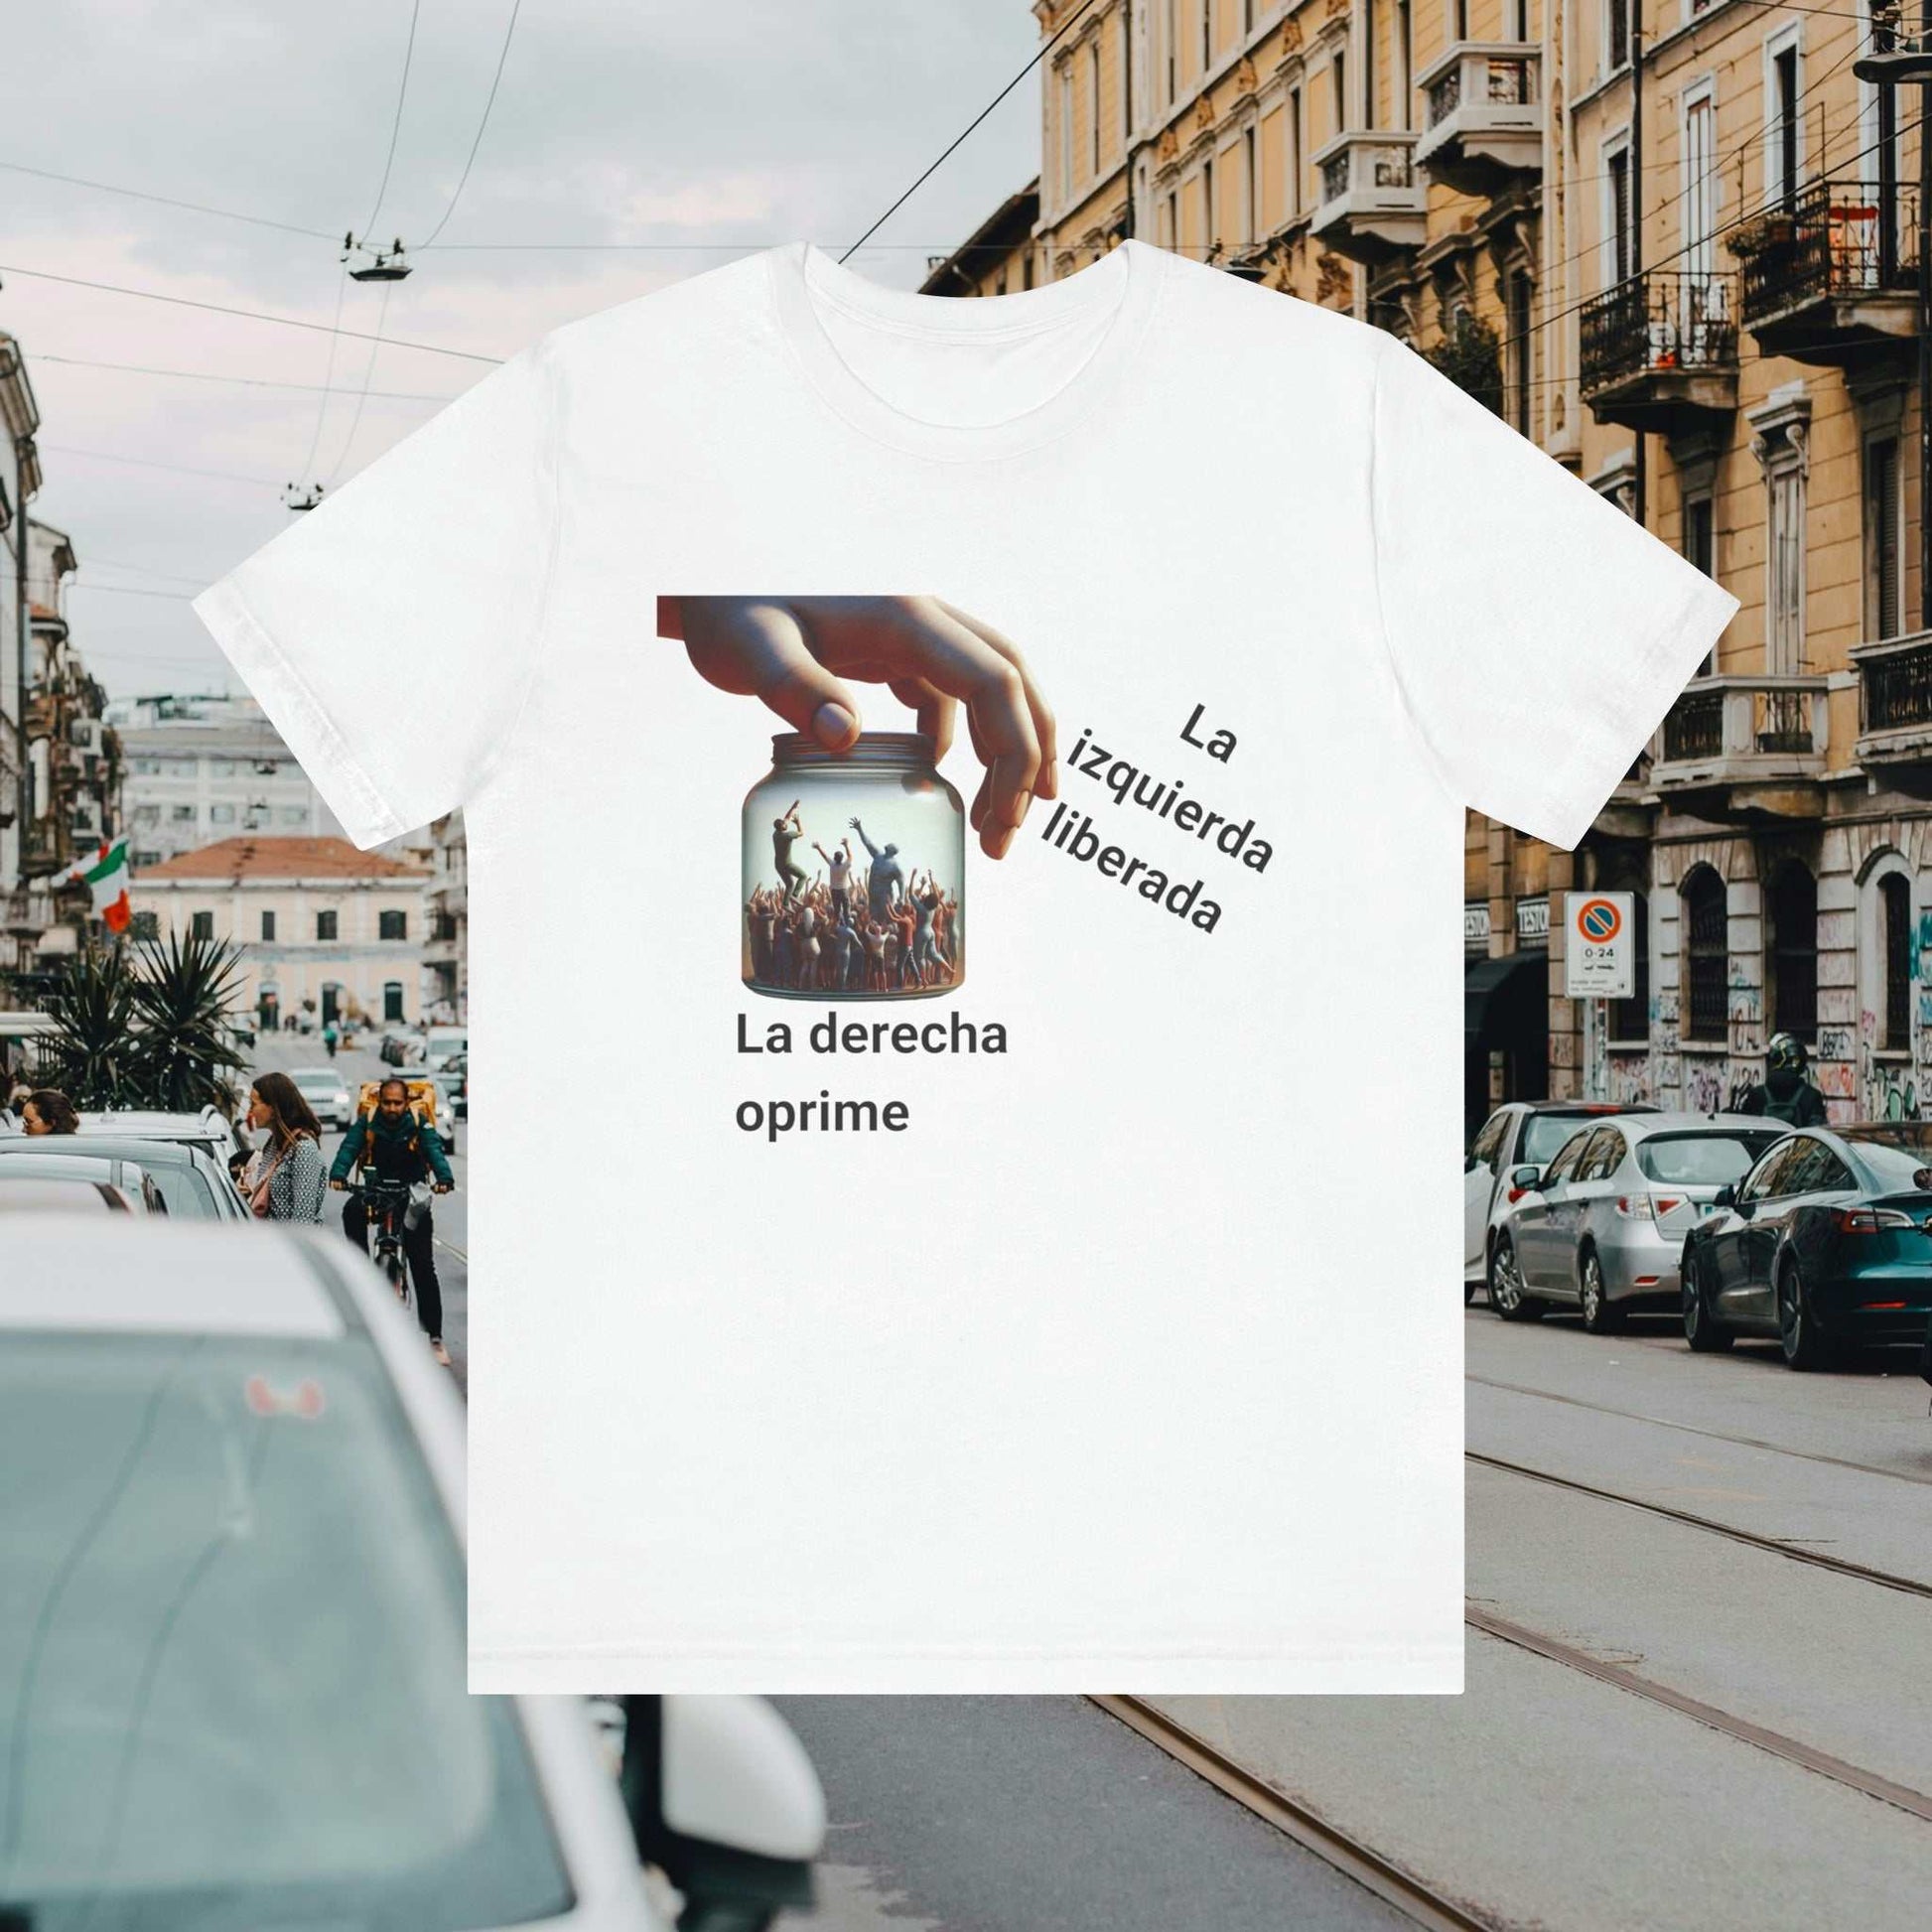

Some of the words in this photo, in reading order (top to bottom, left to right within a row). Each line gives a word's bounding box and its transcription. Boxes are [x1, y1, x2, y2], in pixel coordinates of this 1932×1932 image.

[1179, 703, 1237, 764] La
[1066, 728, 1273, 874] izquierda
[1040, 801, 1222, 934] liberada
[737, 1013, 792, 1054] La
[809, 1011, 1008, 1054] derecha
[736, 1089, 909, 1143] oprime
